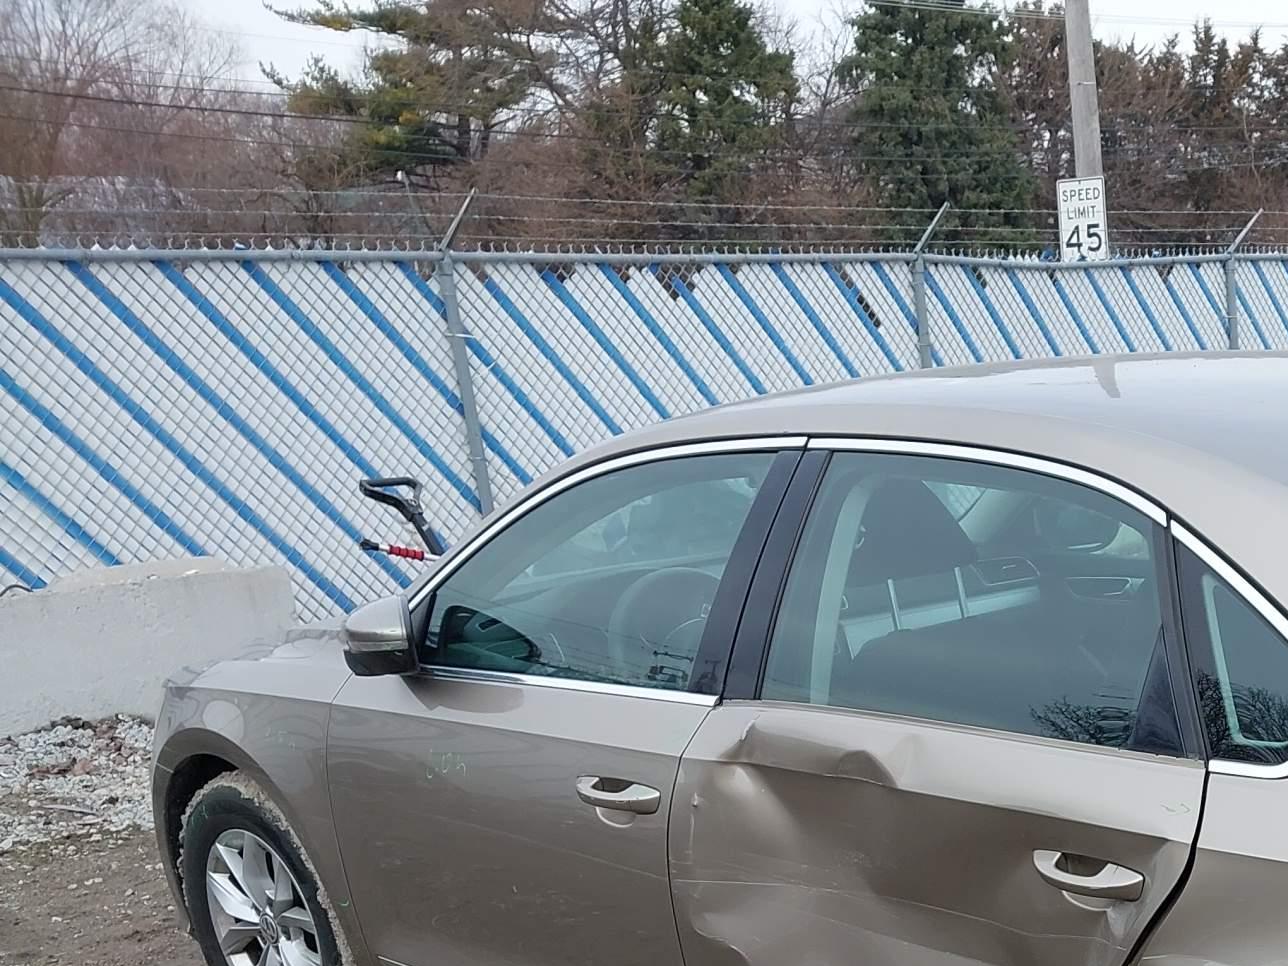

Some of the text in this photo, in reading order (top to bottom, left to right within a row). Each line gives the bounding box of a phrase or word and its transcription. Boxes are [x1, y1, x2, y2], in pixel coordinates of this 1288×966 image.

[1062, 187, 1101, 202] SPEED
[1066, 205, 1096, 220] LIMIT
[1065, 223, 1103, 253] 45
